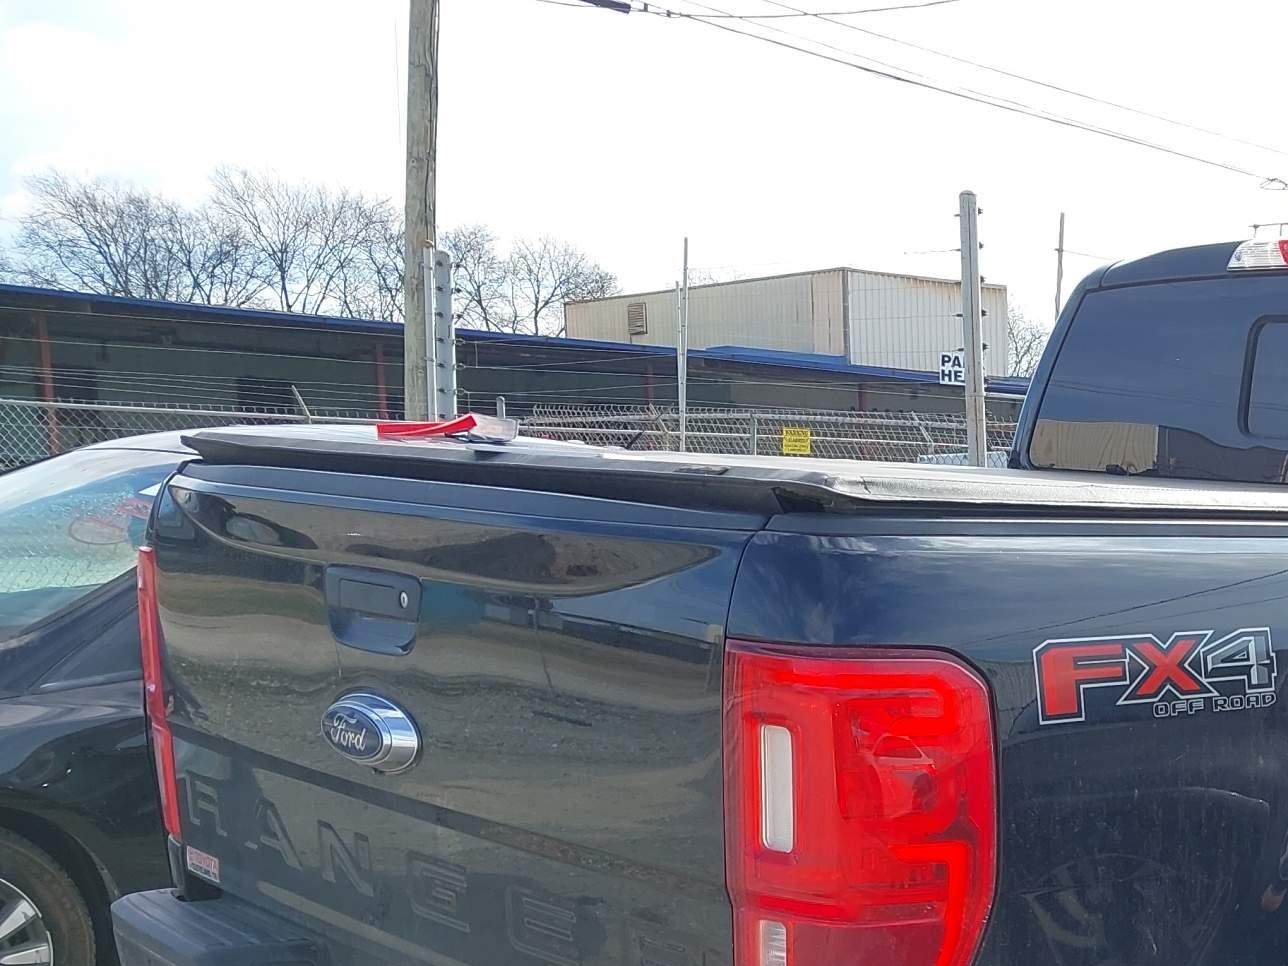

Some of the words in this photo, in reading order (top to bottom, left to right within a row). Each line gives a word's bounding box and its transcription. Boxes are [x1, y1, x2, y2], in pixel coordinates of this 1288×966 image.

[941, 354, 964, 368] PA
[941, 369, 965, 383] HE
[1033, 627, 1277, 725] FX4
[1154, 699, 1204, 718] OFF
[1213, 693, 1277, 712] ROAD
[330, 712, 367, 752] Ford
